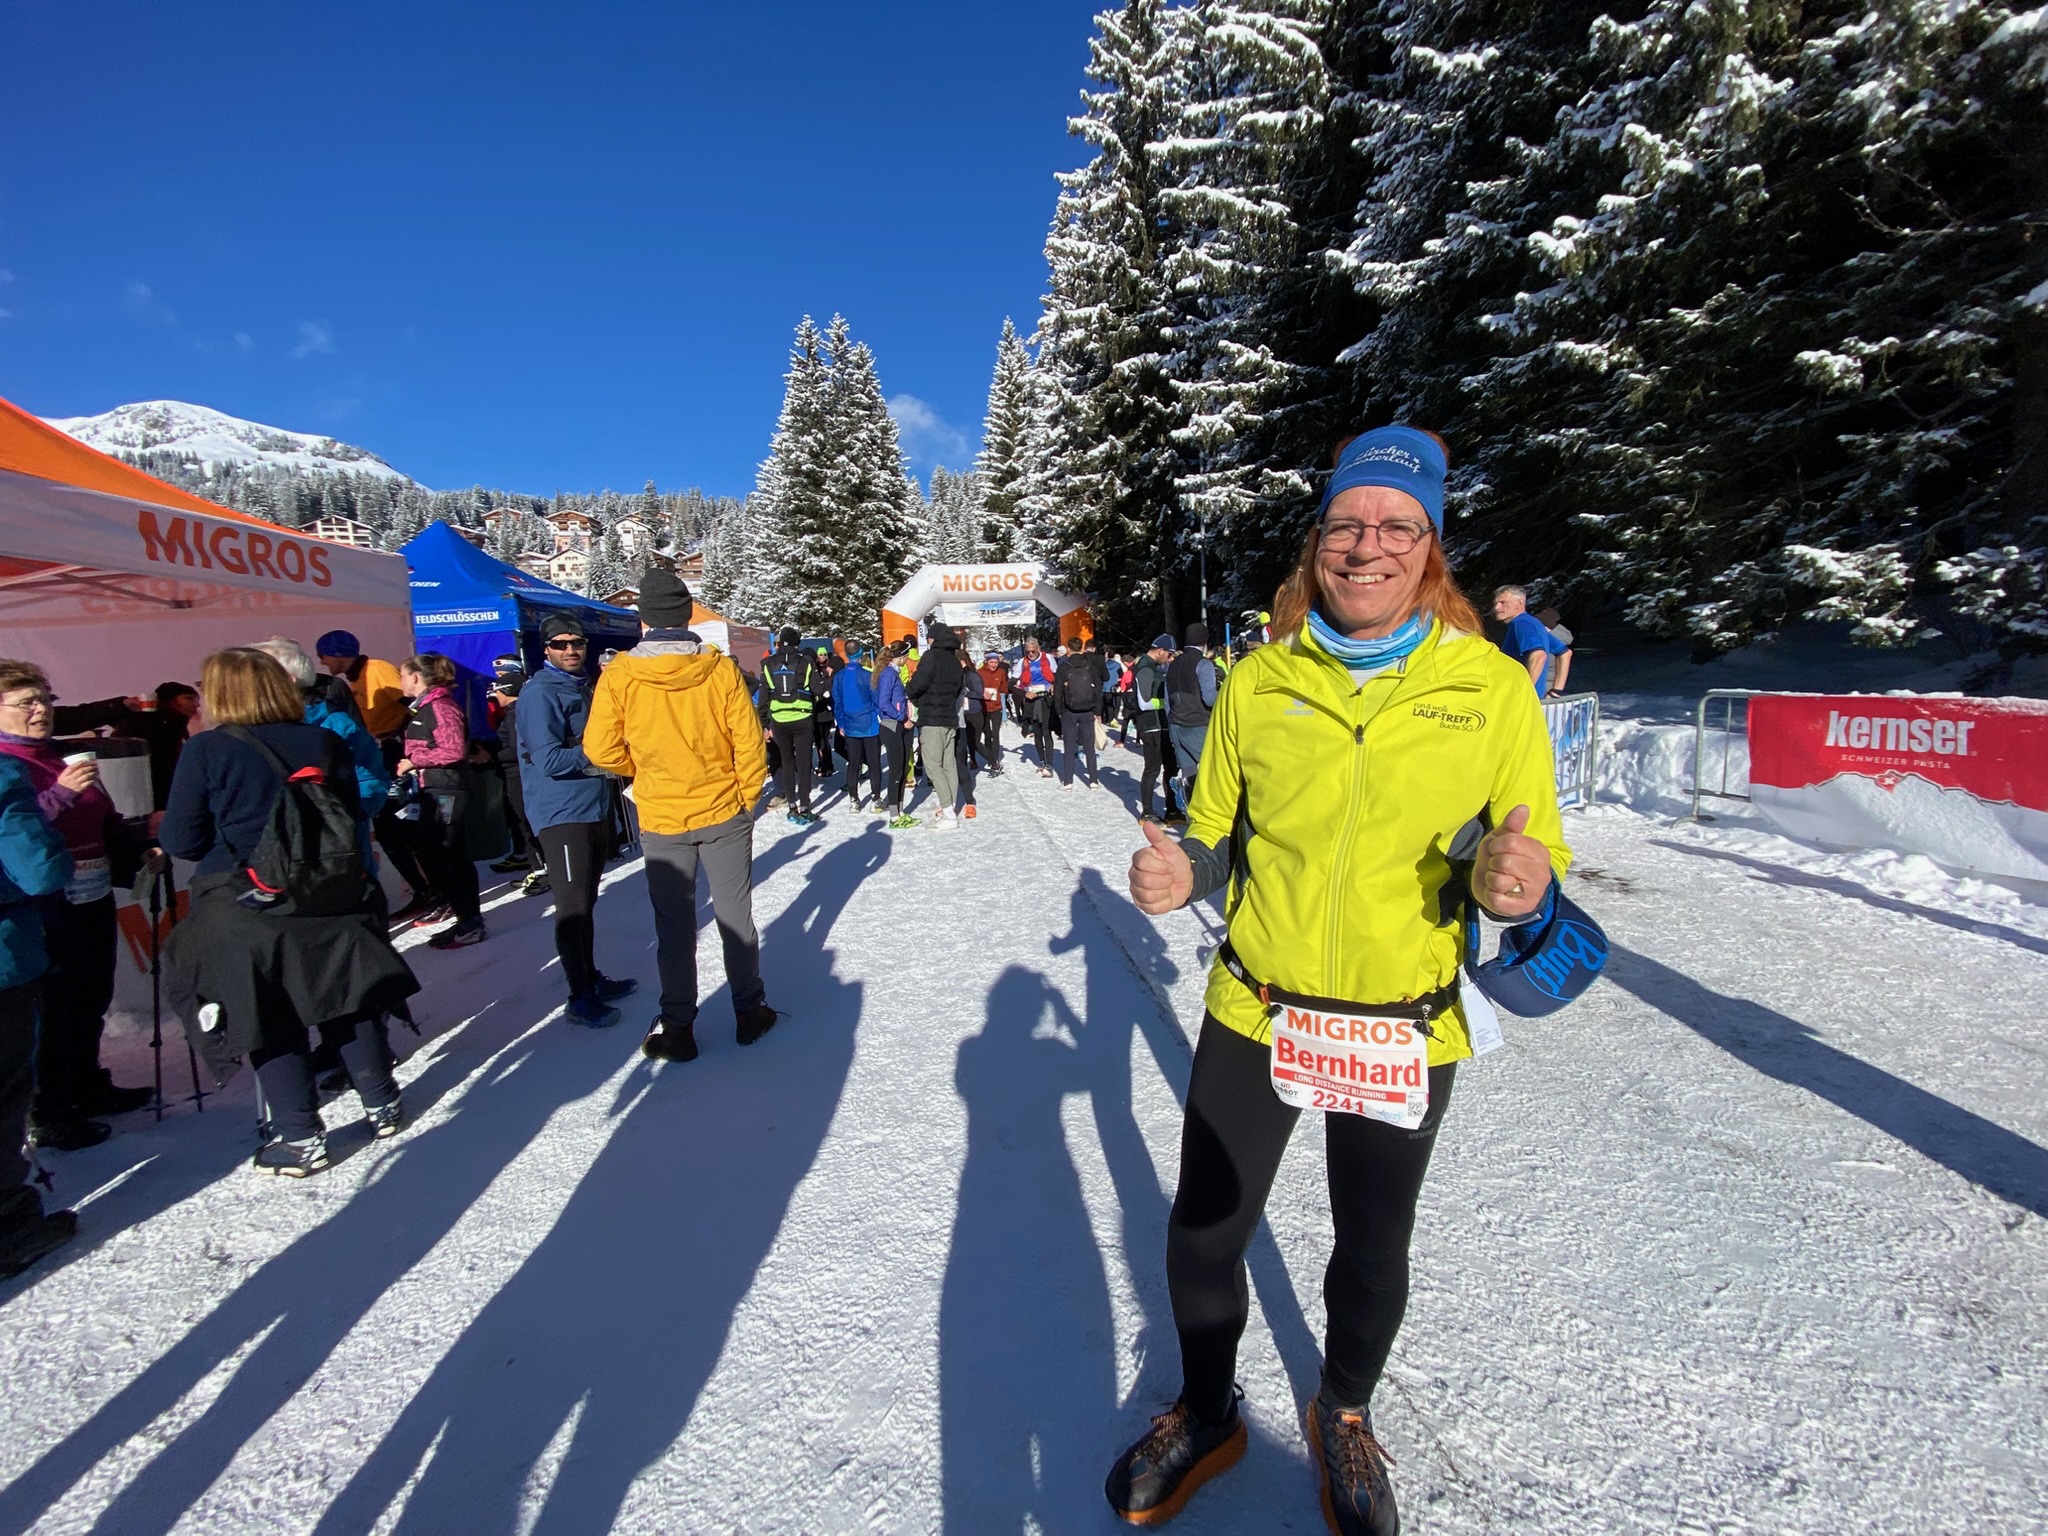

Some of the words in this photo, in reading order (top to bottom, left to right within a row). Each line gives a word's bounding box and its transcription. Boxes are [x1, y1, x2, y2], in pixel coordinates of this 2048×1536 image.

[137, 510, 332, 588] MIGROS
[943, 572, 1034, 592] MIGROS
[416, 611, 499, 625] FELDSCHLÖSSCHEN
[979, 608, 1002, 619] ZIEL
[1412, 707, 1473, 724] LAUF-TREFF
[1440, 721, 1460, 731] Buchs
[1461, 724, 1474, 733] SG
[1825, 710, 1975, 756] kernser
[1841, 754, 1908, 766] SCHWEIZER
[1913, 759, 1951, 769] PASTA
[1527, 922, 1608, 996] Buff
[1286, 1008, 1413, 1045] MIGROS
[1277, 1036, 1421, 1087] Bernhard
[1294, 1073, 1315, 1086] LONG
[1315, 1079, 1350, 1094] DISTANCE
[1351, 1087, 1387, 1100] RUNNING
[1312, 1089, 1366, 1115] 2241
